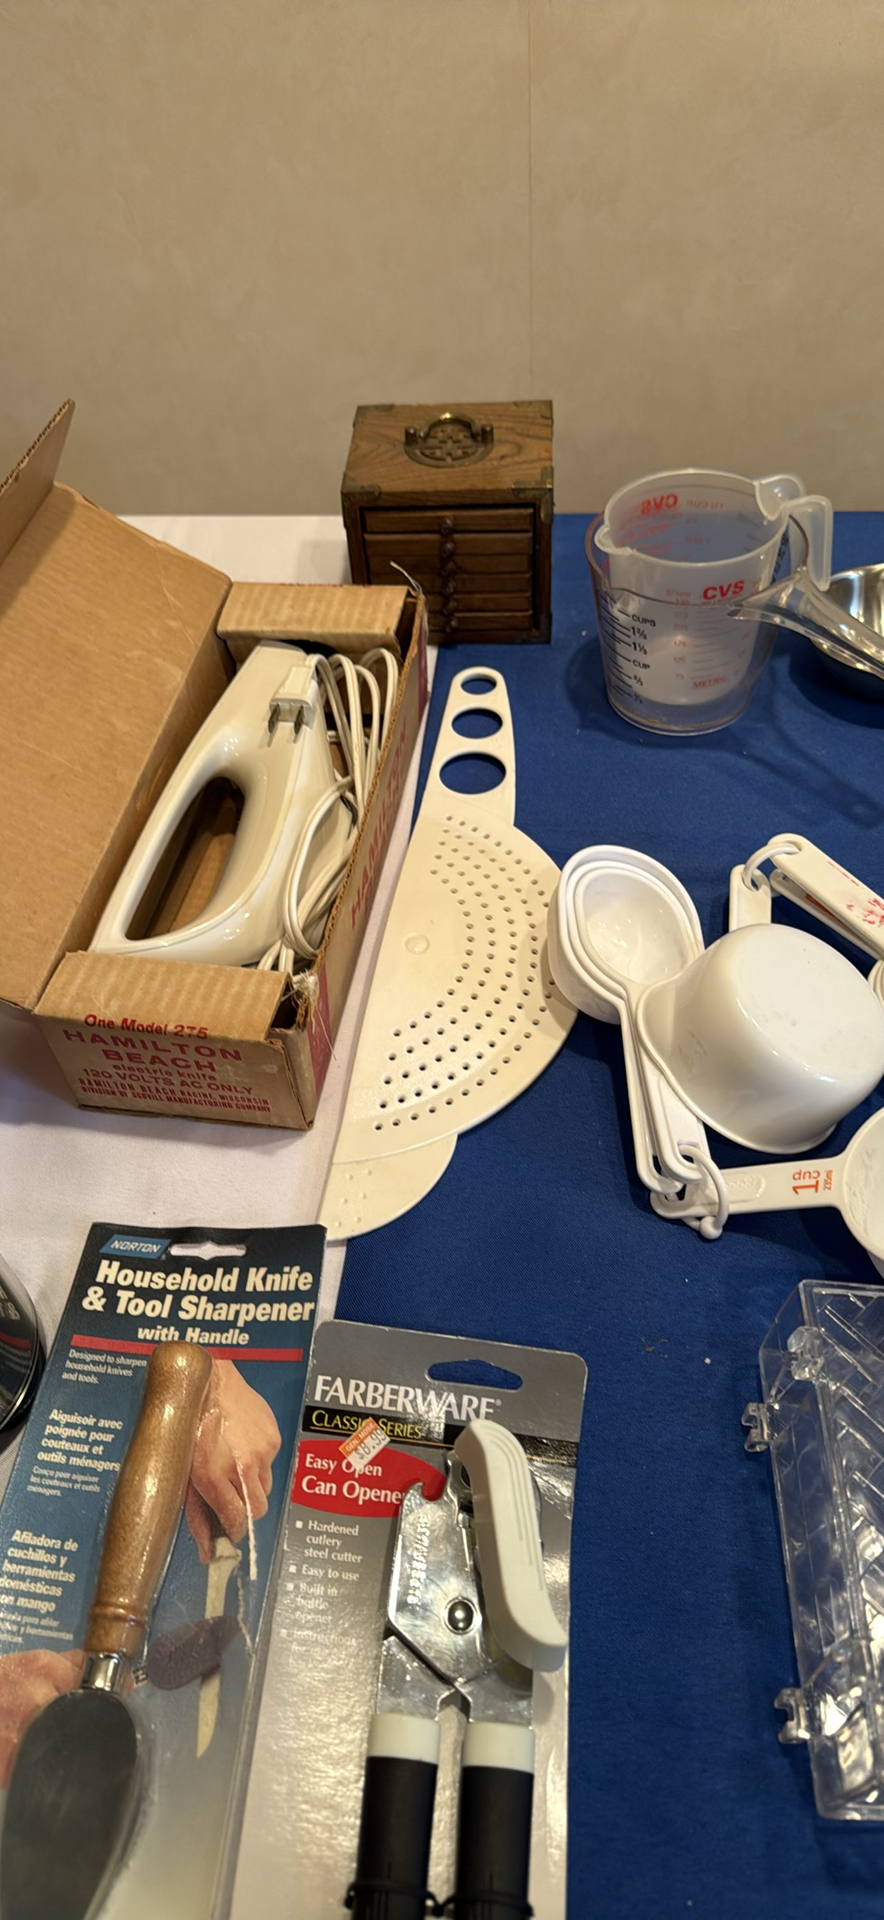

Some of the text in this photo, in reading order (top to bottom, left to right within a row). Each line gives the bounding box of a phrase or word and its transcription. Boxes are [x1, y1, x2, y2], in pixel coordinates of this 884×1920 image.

[702, 579, 745, 600] CVS
[631, 613, 656, 627] CUPS
[632, 659, 651, 670] CUP
[84, 1014, 209, 1040] One Model 275
[62, 1028, 242, 1061] HAMILTON
[101, 1048, 217, 1073] BEACH
[83, 1068, 252, 1095] 120 VOLTS AC ONLY
[112, 1064, 217, 1082] electric knife
[78, 1077, 135, 1091] HAMILTON
[140, 1084, 176, 1096] BEACH
[218, 1094, 269, 1106] WISCONSIN
[81, 1086, 117, 1096] DIVISION
[131, 1091, 164, 1102] SCOVILL
[166, 1095, 233, 1109] MANUFACTURING
[235, 1103, 271, 1113] COMPANY
[110, 1238, 161, 1254] NORTON
[96, 1259, 313, 1292] Household Knife
[81, 1285, 315, 1327] & Tool Sharpener
[137, 1325, 250, 1345] with Handle
[65, 1359, 133, 1377] household knives
[69, 1349, 148, 1368] Designed to sharpen
[62, 1372, 78, 1381] and
[49, 1408, 124, 1430] Aiguisoir avec
[378, 1418, 422, 1440] SERIES
[44, 1423, 115, 1443] poignée pour
[41, 1438, 104, 1455] couteaux et
[354, 1428, 387, 1460] $8.99
[37, 1451, 122, 1472] outils ménagers
[305, 1453, 337, 1475] Easy
[301, 1475, 337, 1496] Can
[308, 1520, 359, 1537] Hardened
[12, 1529, 79, 1551] Afiladora de
[306, 1534, 342, 1549] cutlery
[7, 1547, 68, 1567] cuchillos y
[304, 1547, 363, 1564] steel cutter
[2, 1559, 76, 1582] herramientas
[302, 1564, 360, 1582] Easy to use
[17, 1597, 56, 1613] mango
